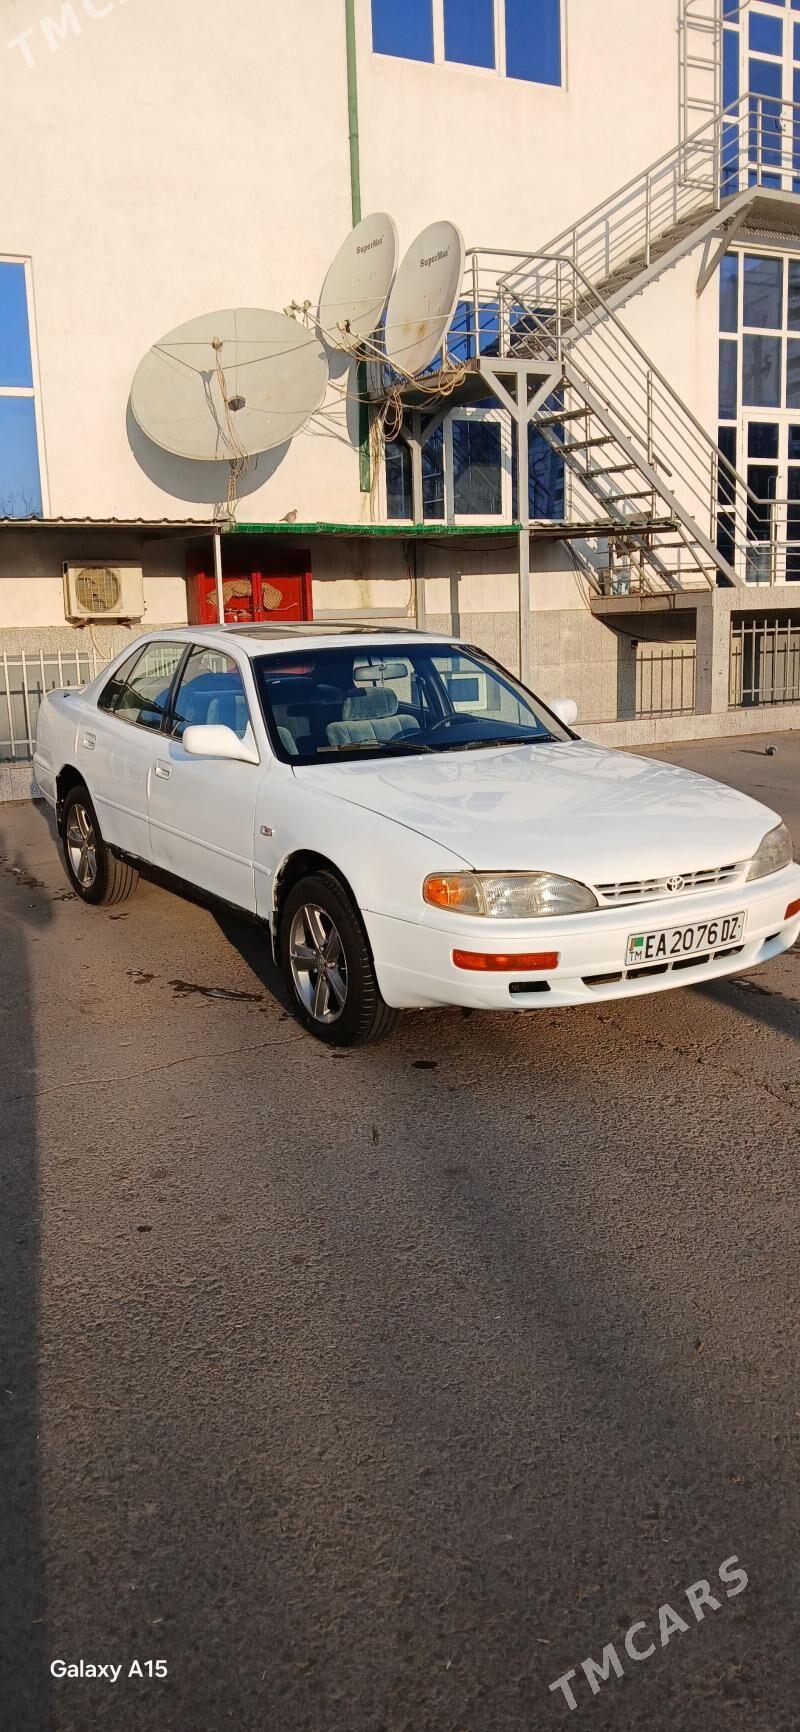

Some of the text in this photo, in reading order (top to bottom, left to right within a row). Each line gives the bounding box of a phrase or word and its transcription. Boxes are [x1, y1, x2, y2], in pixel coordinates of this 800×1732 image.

[356, 238, 383, 254] SuperMax
[420, 250, 448, 268] SuperMax
[629, 950, 642, 962] TM
